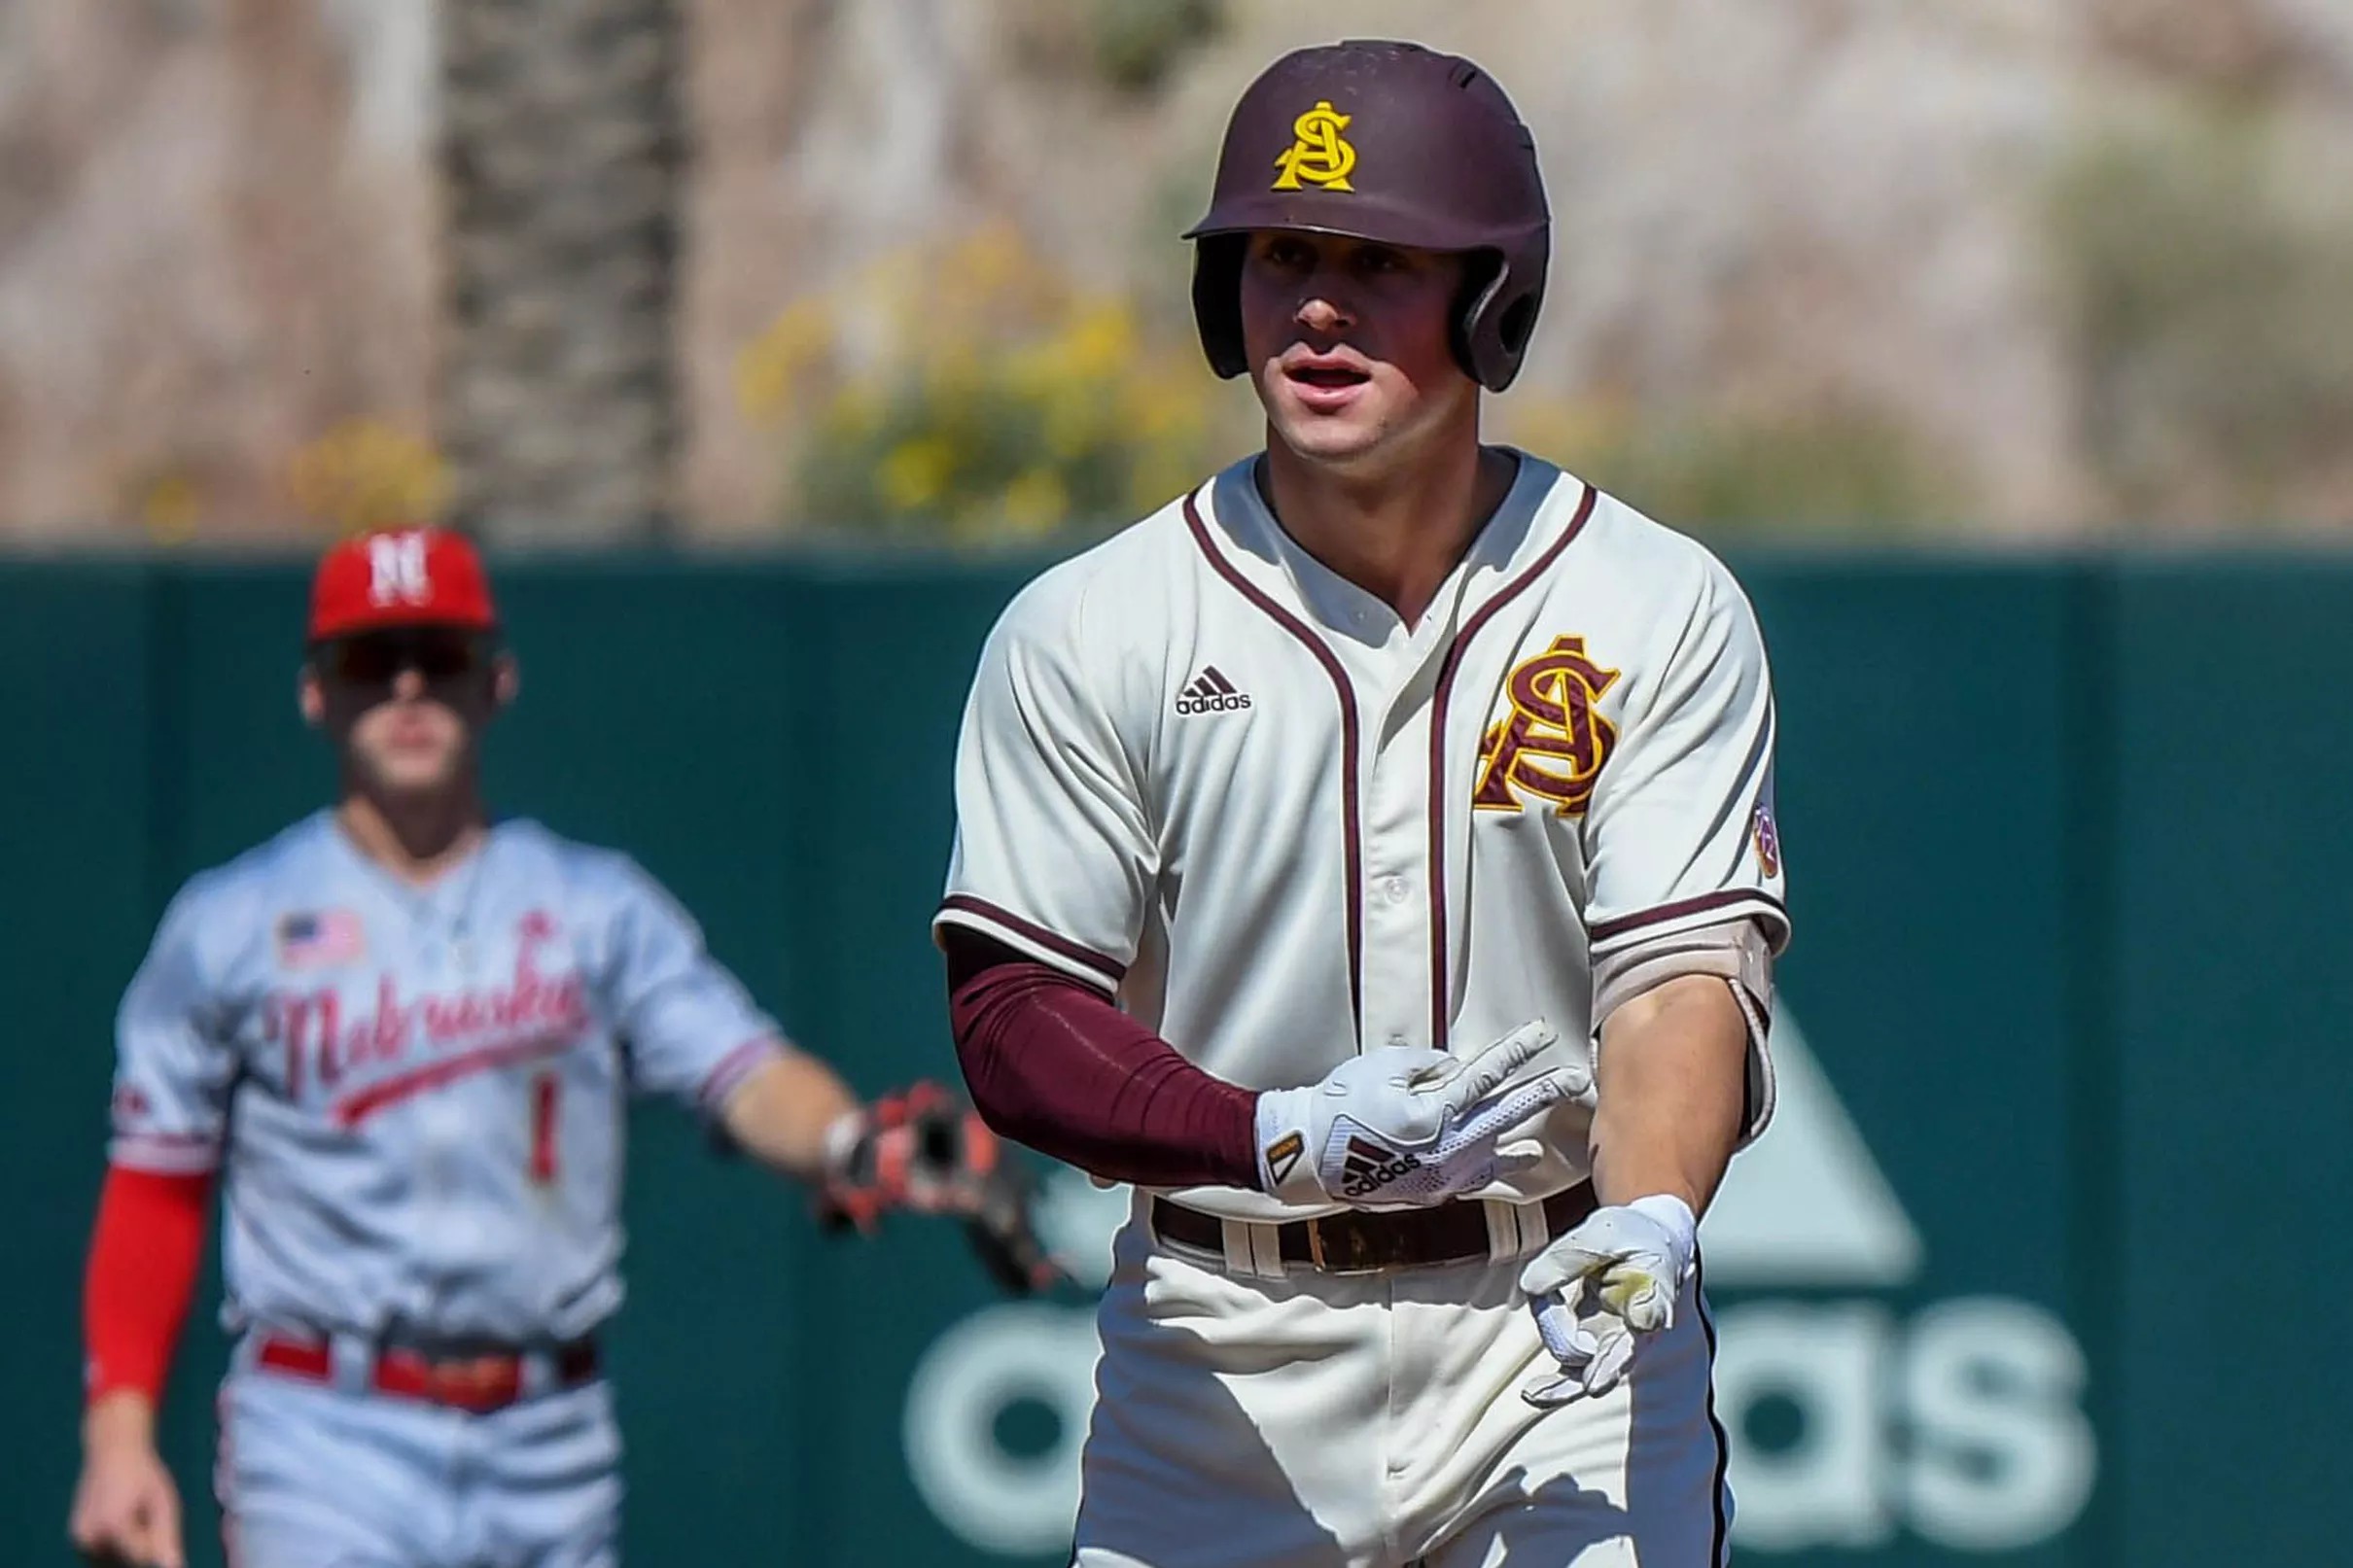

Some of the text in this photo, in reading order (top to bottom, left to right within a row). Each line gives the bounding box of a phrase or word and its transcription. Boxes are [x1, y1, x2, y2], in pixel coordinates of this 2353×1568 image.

[367, 531, 435, 609] N
[1176, 693, 1251, 714] adidas
[528, 1069, 562, 1186] 1
[1344, 1153, 1422, 1197] adidas
